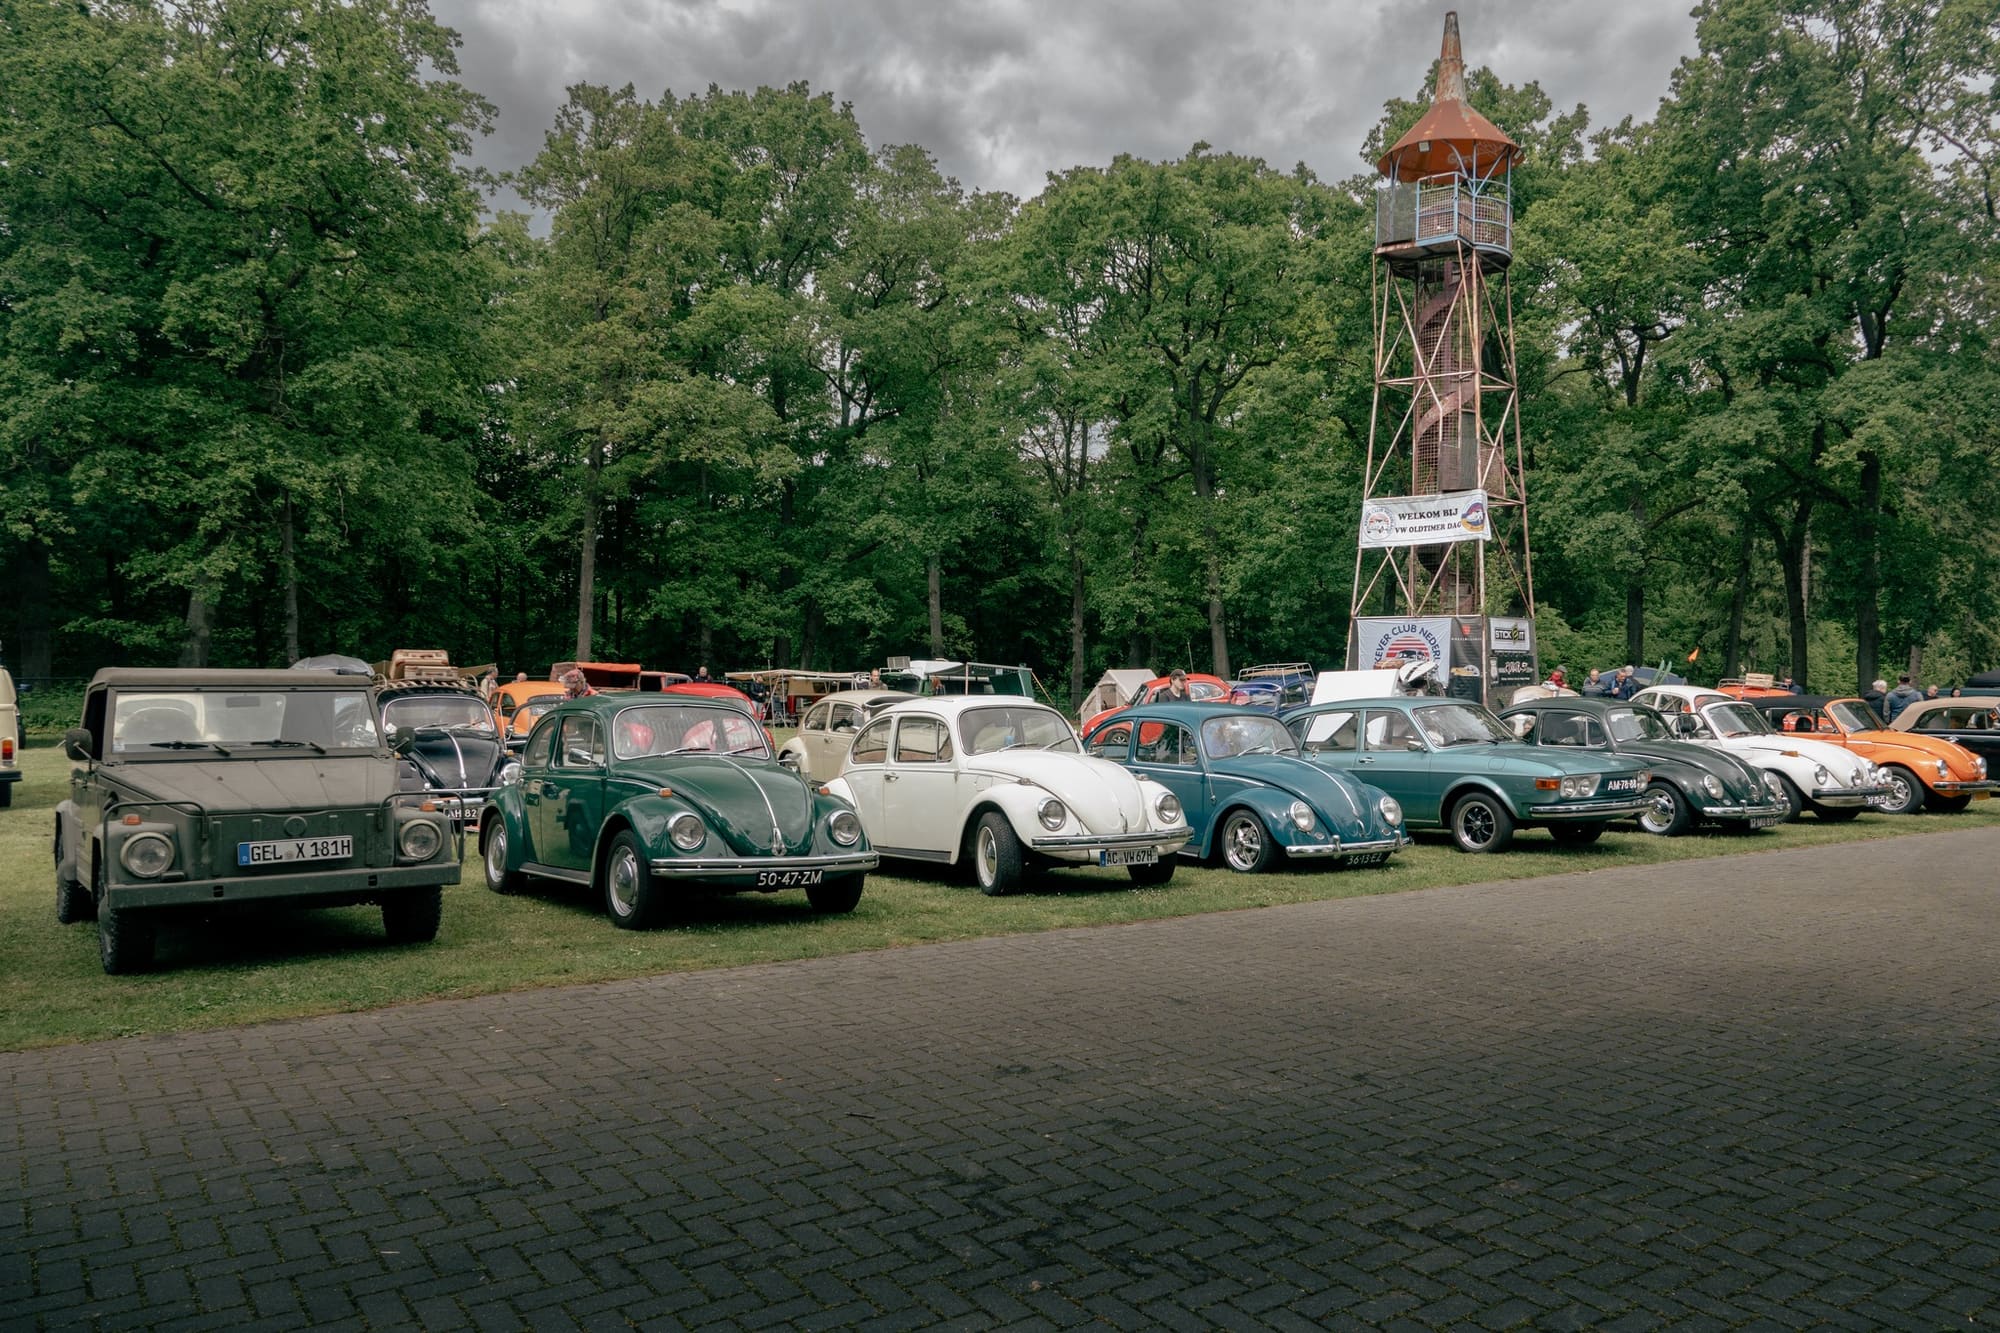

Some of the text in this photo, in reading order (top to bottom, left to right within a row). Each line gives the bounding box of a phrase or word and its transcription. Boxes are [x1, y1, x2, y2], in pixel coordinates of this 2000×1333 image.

[1398, 508, 1458, 521] WELKOM BIJ
[1409, 523, 1446, 533] OLDTIMER
[1391, 624, 1417, 636] CLUB
[251, 844, 283, 862] GEL
[296, 842, 305, 859] X
[310, 839, 351, 858] 181H
[1106, 851, 1118, 865] AC
[1136, 849, 1153, 862] 67H
